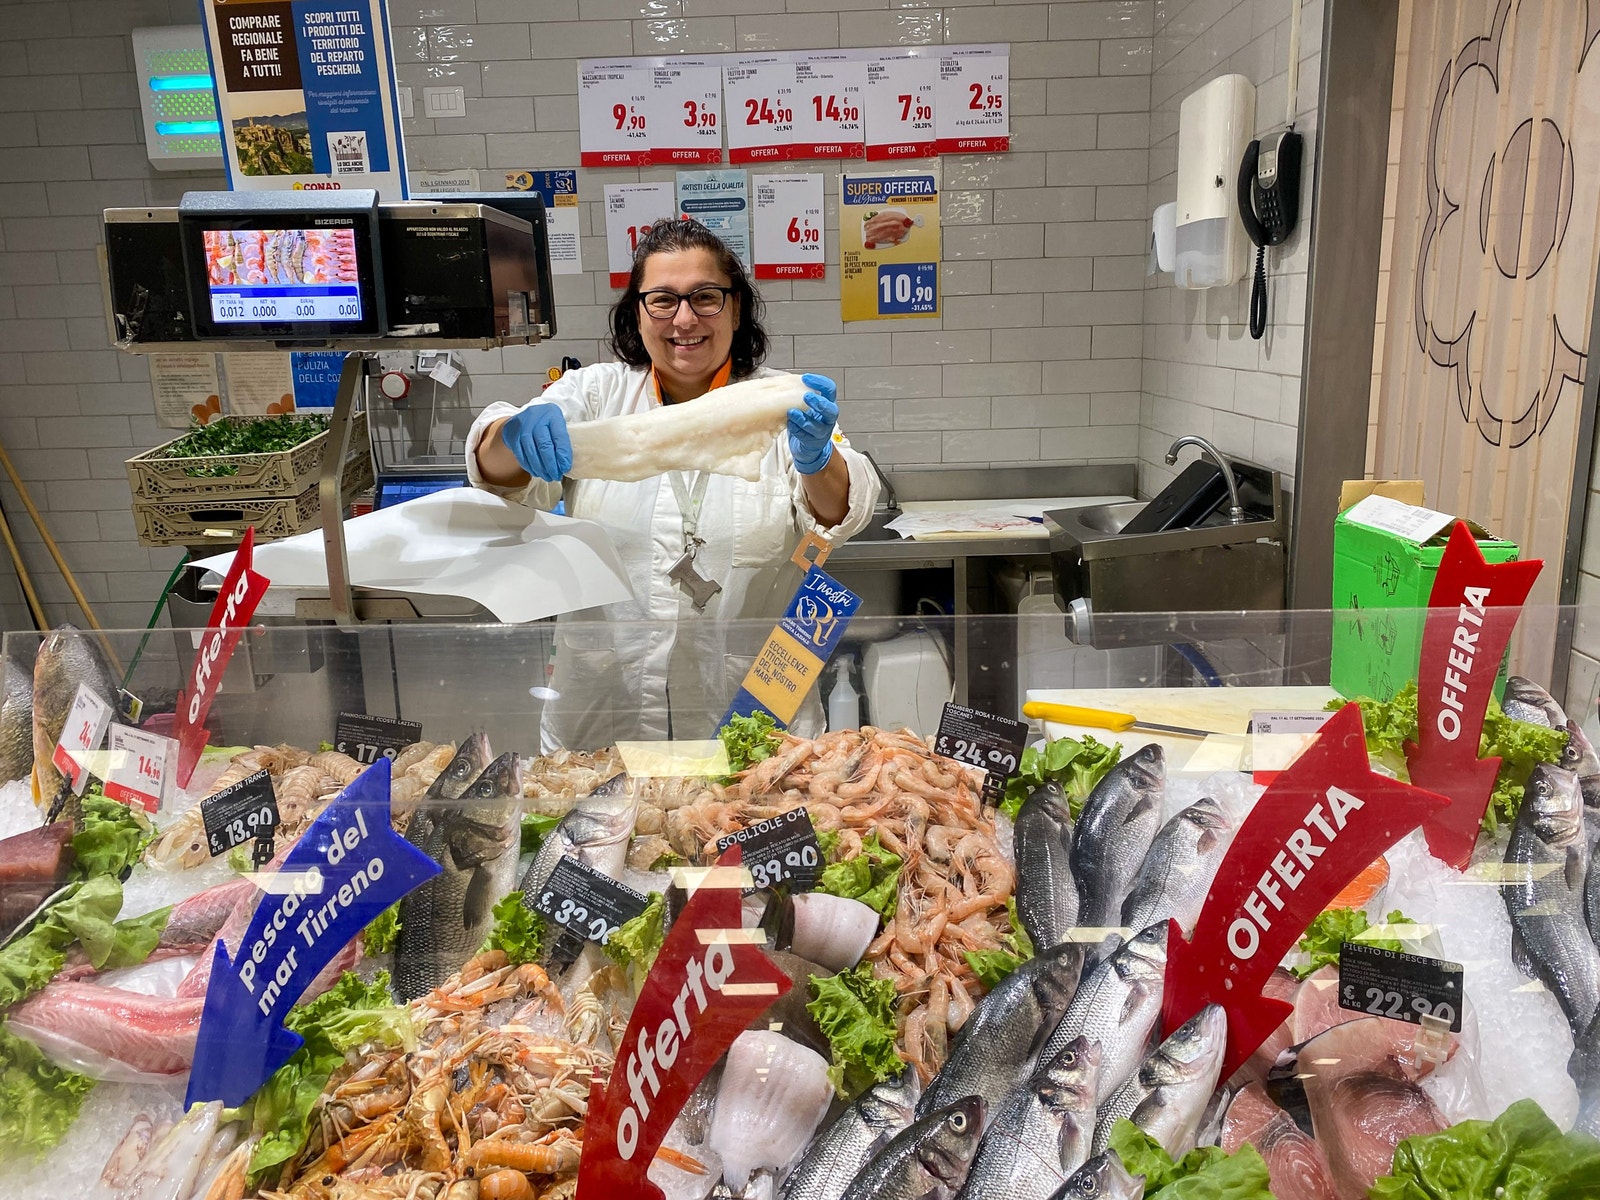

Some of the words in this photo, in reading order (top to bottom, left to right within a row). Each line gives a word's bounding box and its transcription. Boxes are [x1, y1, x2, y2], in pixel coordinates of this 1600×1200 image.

[229, 15, 281, 30] COMPRARE
[304, 12, 334, 24] SCOPRI
[335, 10, 361, 23] TUTTI
[232, 30, 284, 46] REGIONALE
[302, 26, 307, 38] I
[308, 25, 348, 37] PRODOTTI
[349, 24, 366, 36] DEL
[311, 37, 360, 50] TERRITORIO
[241, 49, 253, 62] FA
[254, 48, 280, 61] BENE
[310, 51, 327, 63] DEL
[328, 50, 365, 63] REPARTO
[243, 66, 251, 78] A
[251, 64, 283, 77] TUTTI!
[317, 63, 362, 76] PESCHERIA
[969, 83, 1002, 110] 2,95
[683, 101, 716, 128] 3,90
[745, 98, 793, 126] 24,90
[812, 95, 859, 122] 14,90
[898, 94, 931, 121] 7,90
[612, 104, 646, 131] 9,90
[751, 148, 779, 157] OFFERTA
[814, 146, 842, 154] OFFERTA
[888, 146, 916, 154] OFFERTA
[958, 140, 986, 148] OFFERTA
[602, 154, 631, 162] OFFERTA
[672, 151, 700, 159] OFFERTA
[303, 182, 341, 190] CONAD
[847, 182, 882, 195] SUPER
[884, 181, 932, 194] OFFERTA
[787, 217, 819, 244] 6,90
[776, 266, 803, 274] OFFERTA
[880, 274, 933, 304] 10,90
[220, 306, 244, 318] 0,012
[253, 306, 277, 317] 0,000
[296, 305, 315, 317] 0,00
[339, 304, 358, 316] 0,00
[297, 361, 330, 371] PULIZIA
[298, 373, 325, 383] DELLE
[327, 373, 342, 383] COZ
[816, 578, 854, 608] nostri
[188, 569, 249, 725] offerta
[763, 649, 788, 672] ITTICHE
[769, 640, 809, 677] ECCELLENZE
[1436, 585, 1492, 741] OFFERTA
[753, 667, 773, 686] MARE
[758, 657, 771, 673] DEL
[771, 669, 797, 693] NOSTRO
[340, 711, 374, 721] PANNOCCHIE
[946, 702, 974, 714] GAMBERO
[975, 710, 991, 719] ROSA
[337, 742, 346, 753] €
[939, 736, 949, 748] €
[139, 755, 160, 780] 14,90
[202, 787, 233, 809] PALOMBO
[235, 783, 243, 792] IN
[244, 768, 269, 787] TRANCI
[225, 807, 273, 847] 13.90
[719, 817, 783, 850] SOGLIOLE
[210, 833, 219, 847] €
[752, 845, 818, 889] 39.90
[1227, 785, 1365, 960] OFFERTA
[563, 855, 593, 873] BRANZINI
[592, 869, 615, 886] PESCATI
[616, 881, 649, 904] 800/1000
[238, 865, 320, 993] pescato
[328, 807, 370, 866] del
[541, 891, 554, 905] €
[258, 946, 300, 1017] mar
[296, 856, 385, 948] Tirreno
[1343, 942, 1381, 956] FILETTO
[1384, 950, 1396, 959] DI
[1400, 953, 1428, 965] PESCE
[1342, 999, 1351, 1007] AL
[1343, 985, 1355, 1000] €
[1365, 987, 1456, 1025] 22.90
[617, 928, 735, 1161] offerta
